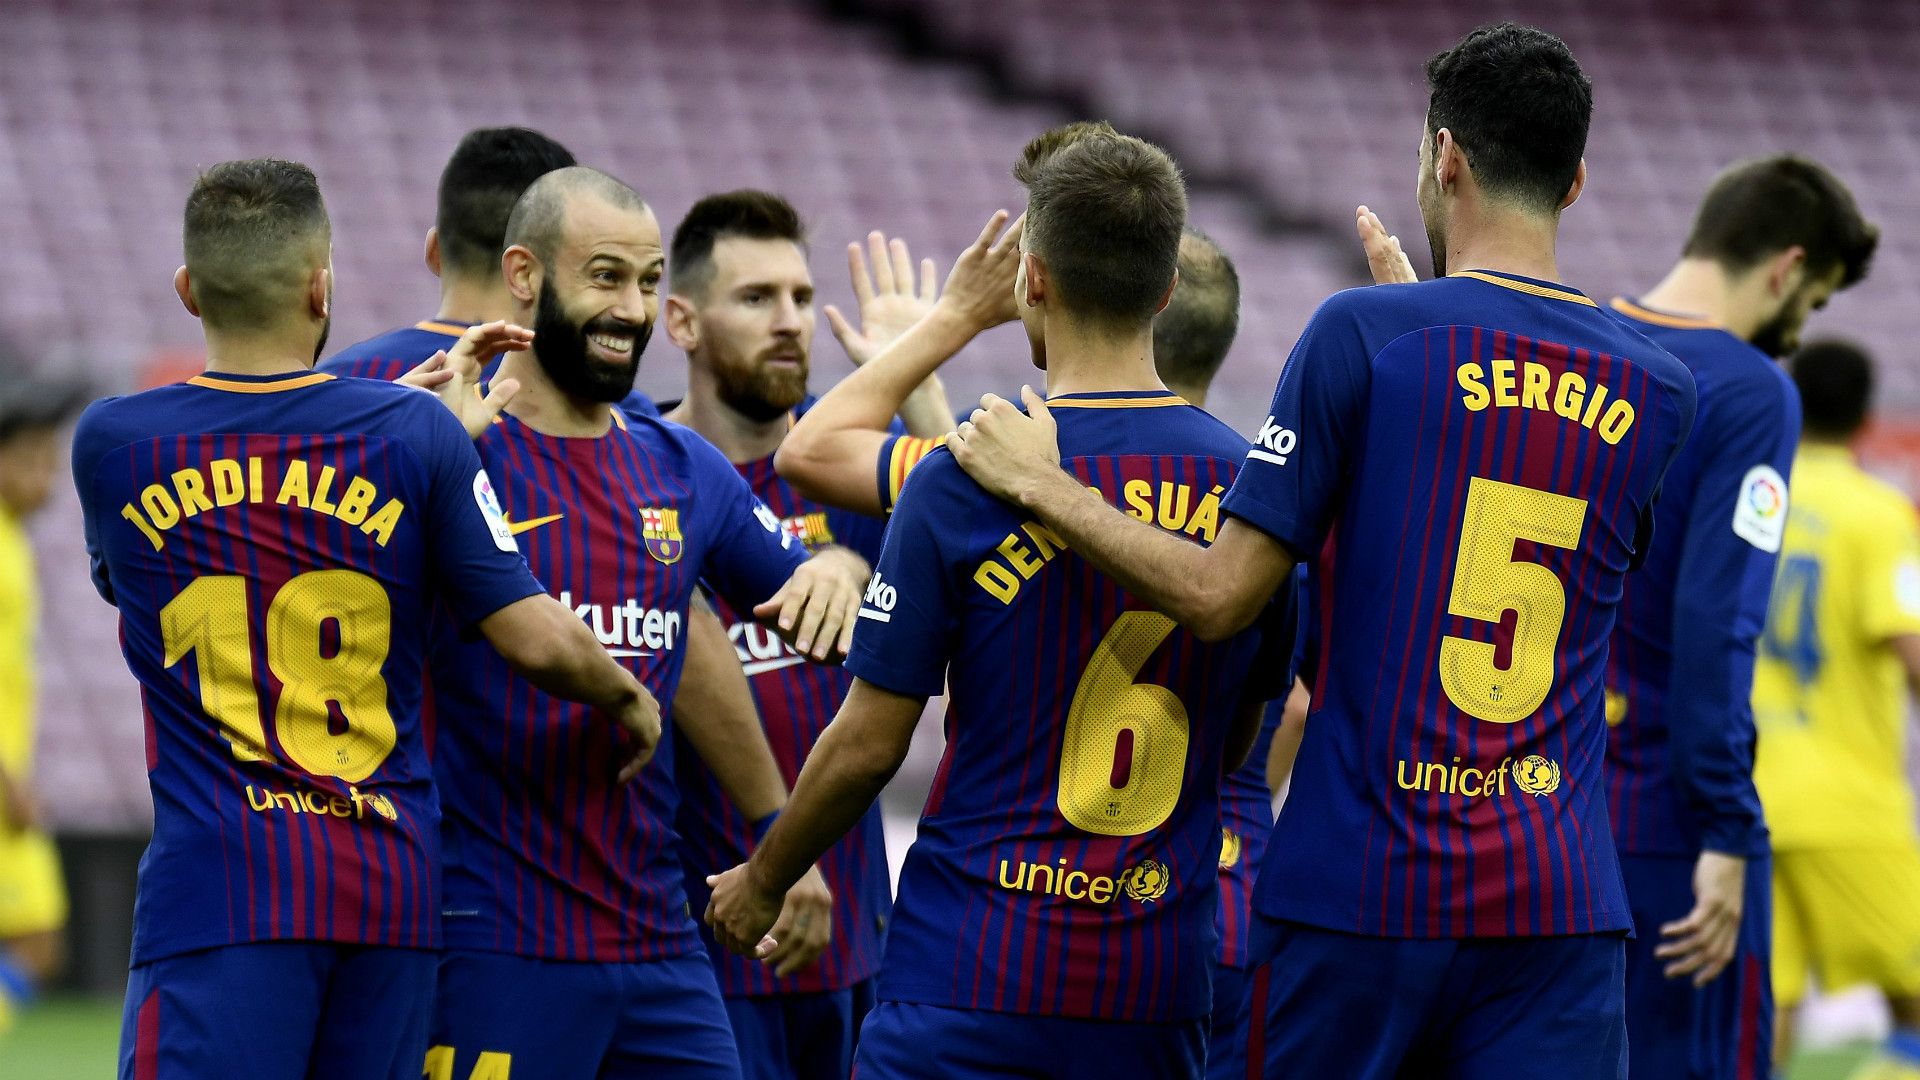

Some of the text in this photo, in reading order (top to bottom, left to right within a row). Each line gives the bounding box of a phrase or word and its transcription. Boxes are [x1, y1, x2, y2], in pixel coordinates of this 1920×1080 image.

[1457, 359, 1635, 445] SERGIO
[1254, 415, 1297, 455] ko
[121, 456, 405, 552] JORDI ALBA
[1124, 479, 1225, 543] SUÁ
[864, 571, 897, 612] ko
[1439, 476, 1589, 724] 5
[159, 569, 397, 783] 18
[1057, 610, 1190, 837] 6
[245, 782, 364, 820] unicef
[1397, 756, 1512, 798] unicef
[999, 858, 1133, 904] unicef
